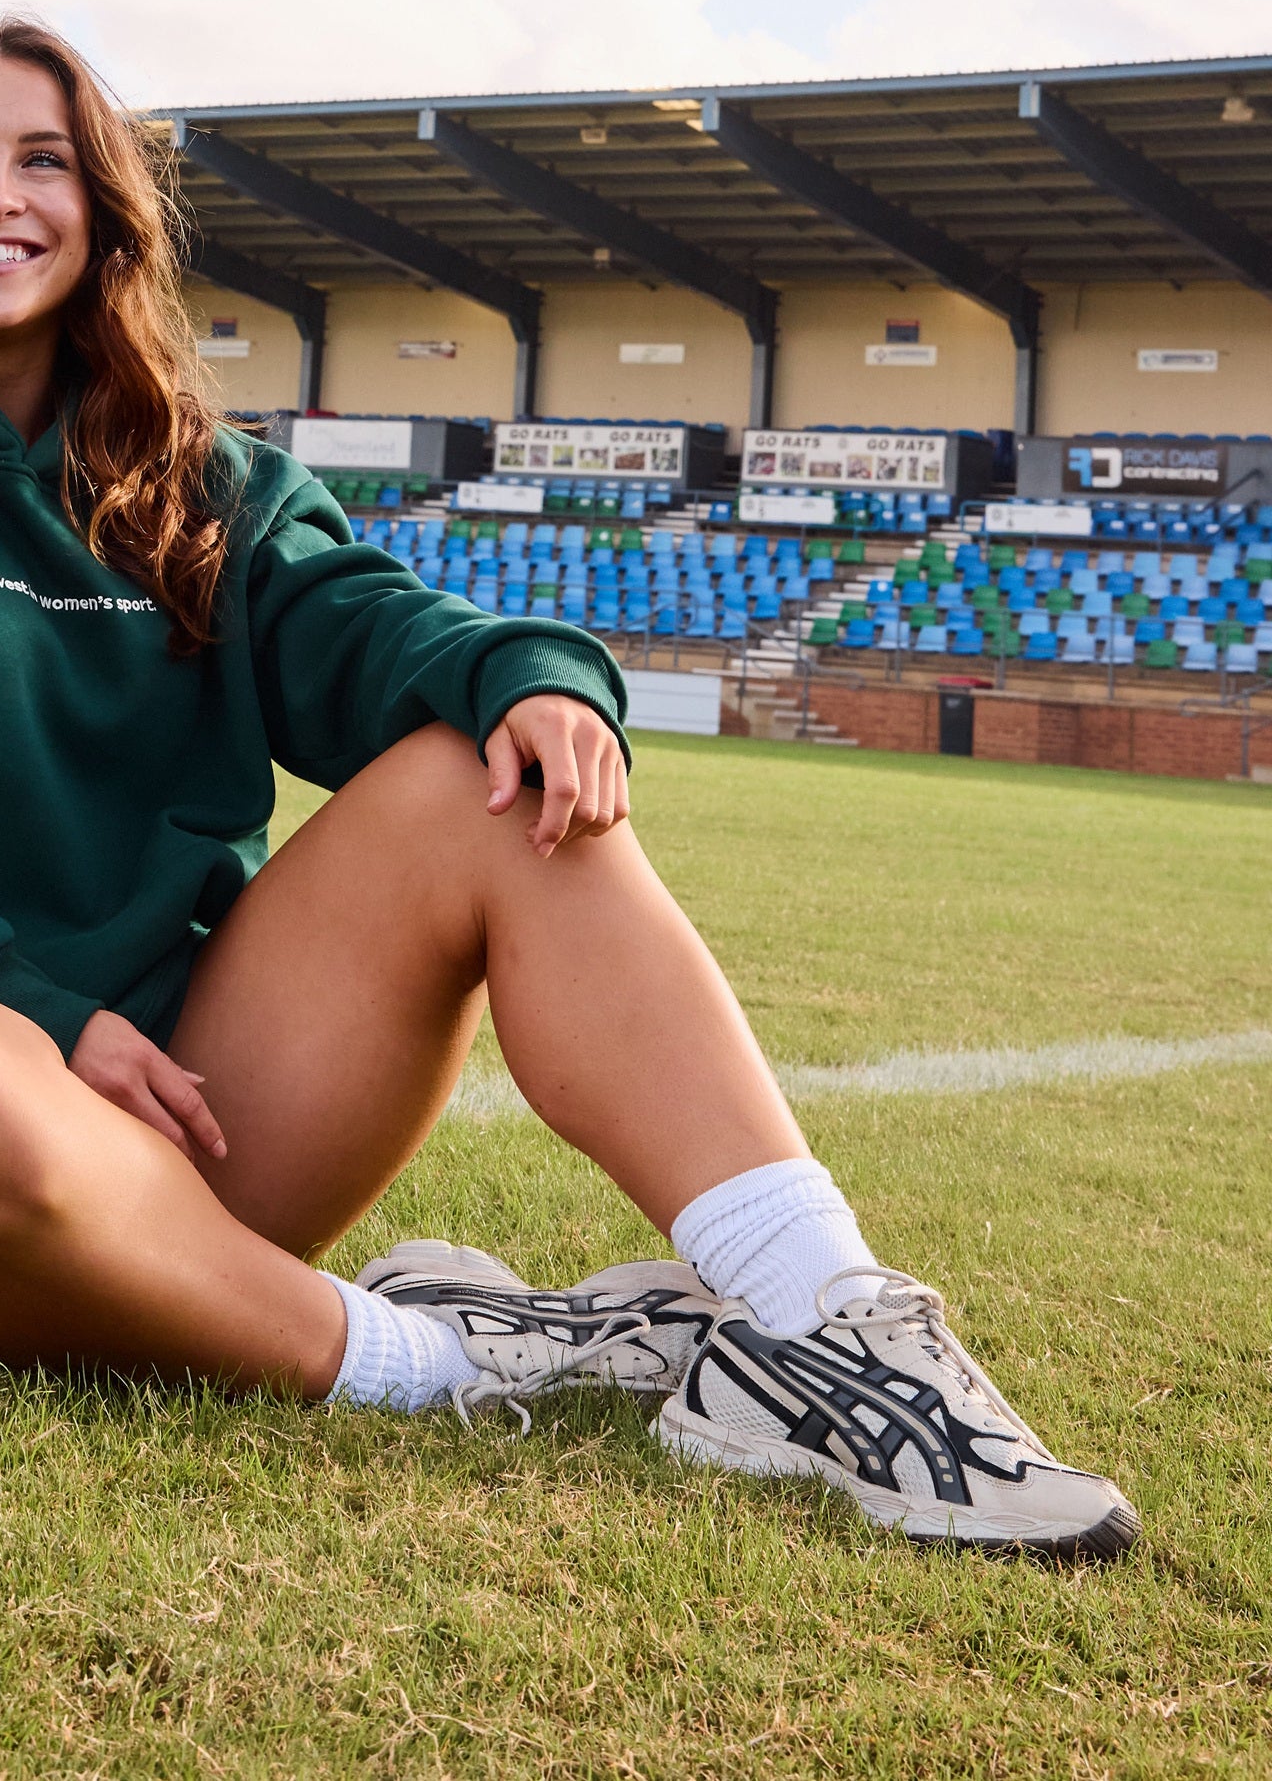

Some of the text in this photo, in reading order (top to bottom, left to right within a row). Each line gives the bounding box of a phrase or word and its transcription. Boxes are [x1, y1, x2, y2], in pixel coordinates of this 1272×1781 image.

[509, 429, 672, 443] GO RATS GO RATS
[755, 435, 936, 451] GO RATS GO RATS
[39, 596, 114, 611] women's
[116, 597, 157, 614] sport.
